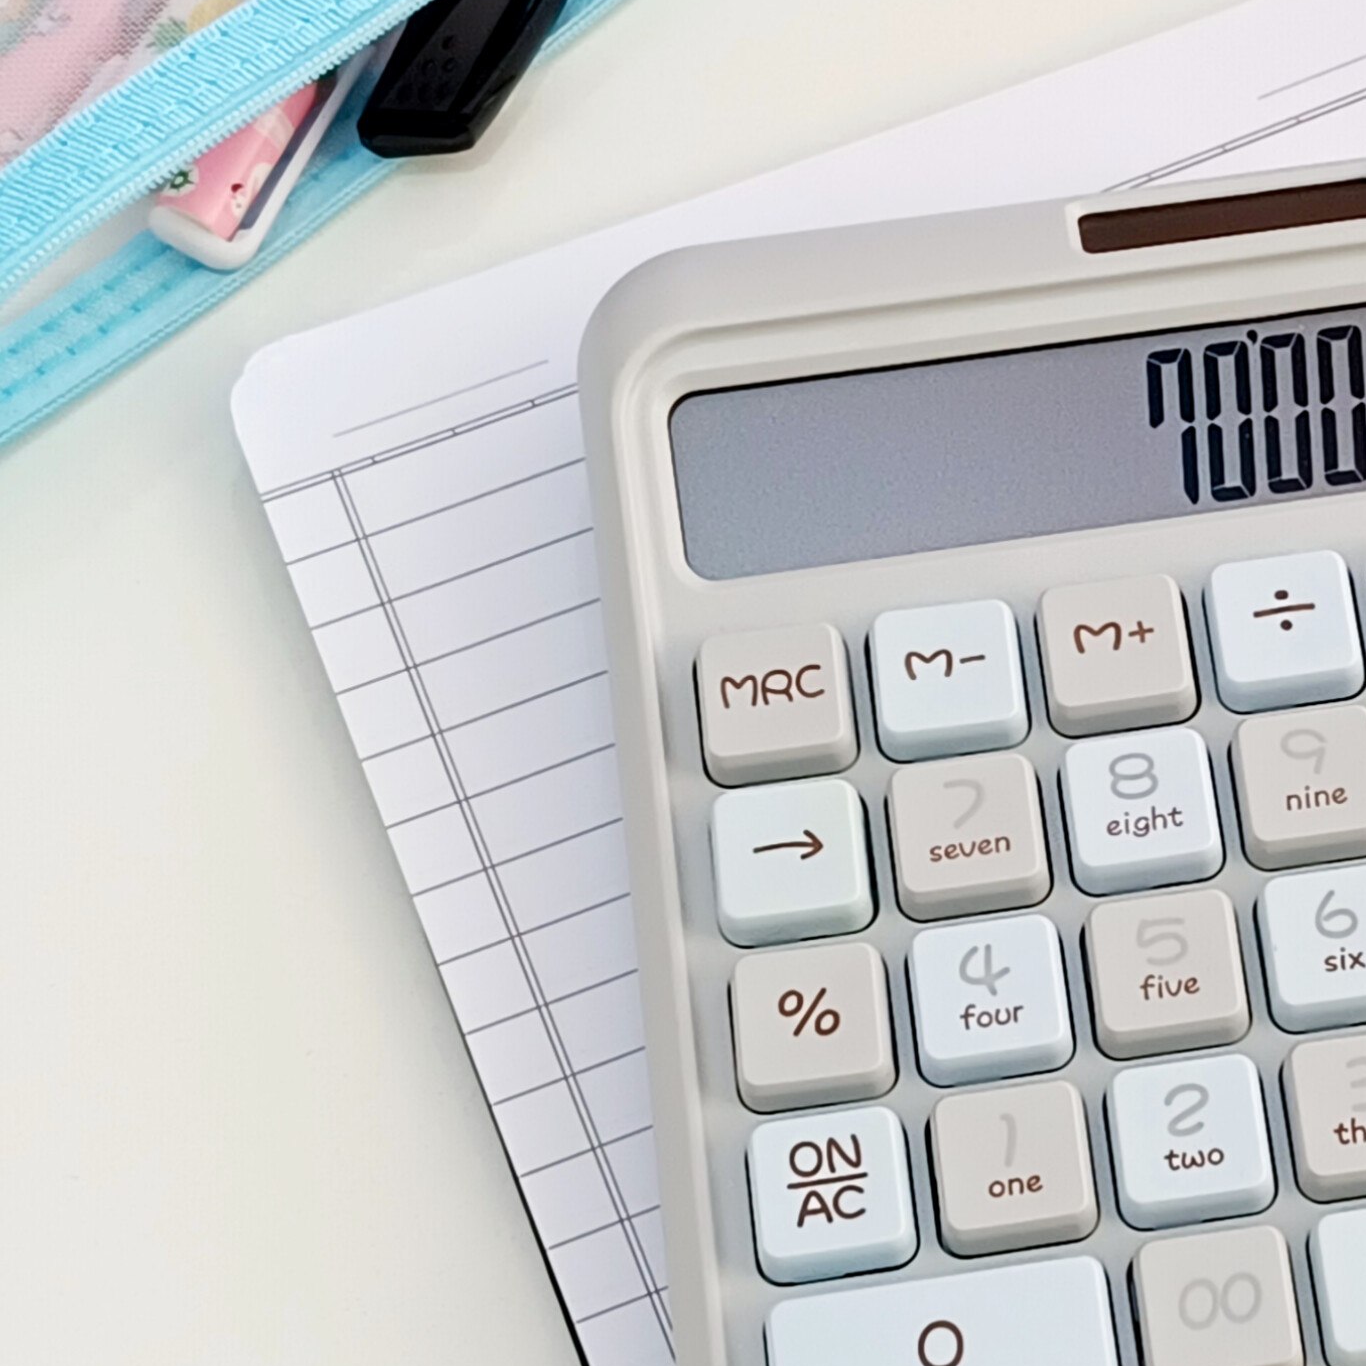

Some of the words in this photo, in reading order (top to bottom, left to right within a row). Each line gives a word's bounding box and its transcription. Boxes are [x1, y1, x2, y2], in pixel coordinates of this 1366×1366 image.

[1073, 620, 1155, 655] M+
[720, 663, 825, 709] MRC
[1279, 728, 1328, 776] 9
[1108, 752, 1159, 801] 8
[1286, 785, 1348, 812] nine
[942, 778, 986, 830] 7
[1106, 805, 1184, 838] eight
[929, 835, 1011, 863] seven
[1314, 889, 1359, 940] 6
[1135, 916, 1190, 967] 5
[1324, 946, 1366, 973] six
[958, 943, 1011, 997] 4
[1139, 973, 1201, 1001] five
[777, 987, 841, 1037] %
[959, 1003, 1024, 1031] four
[1163, 1082, 1210, 1138] 2
[788, 1133, 862, 1176] ON
[1163, 1147, 1225, 1172] two
[797, 1184, 867, 1228] AC
[988, 1174, 1044, 1198] one
[1177, 1271, 1263, 1331] 00
